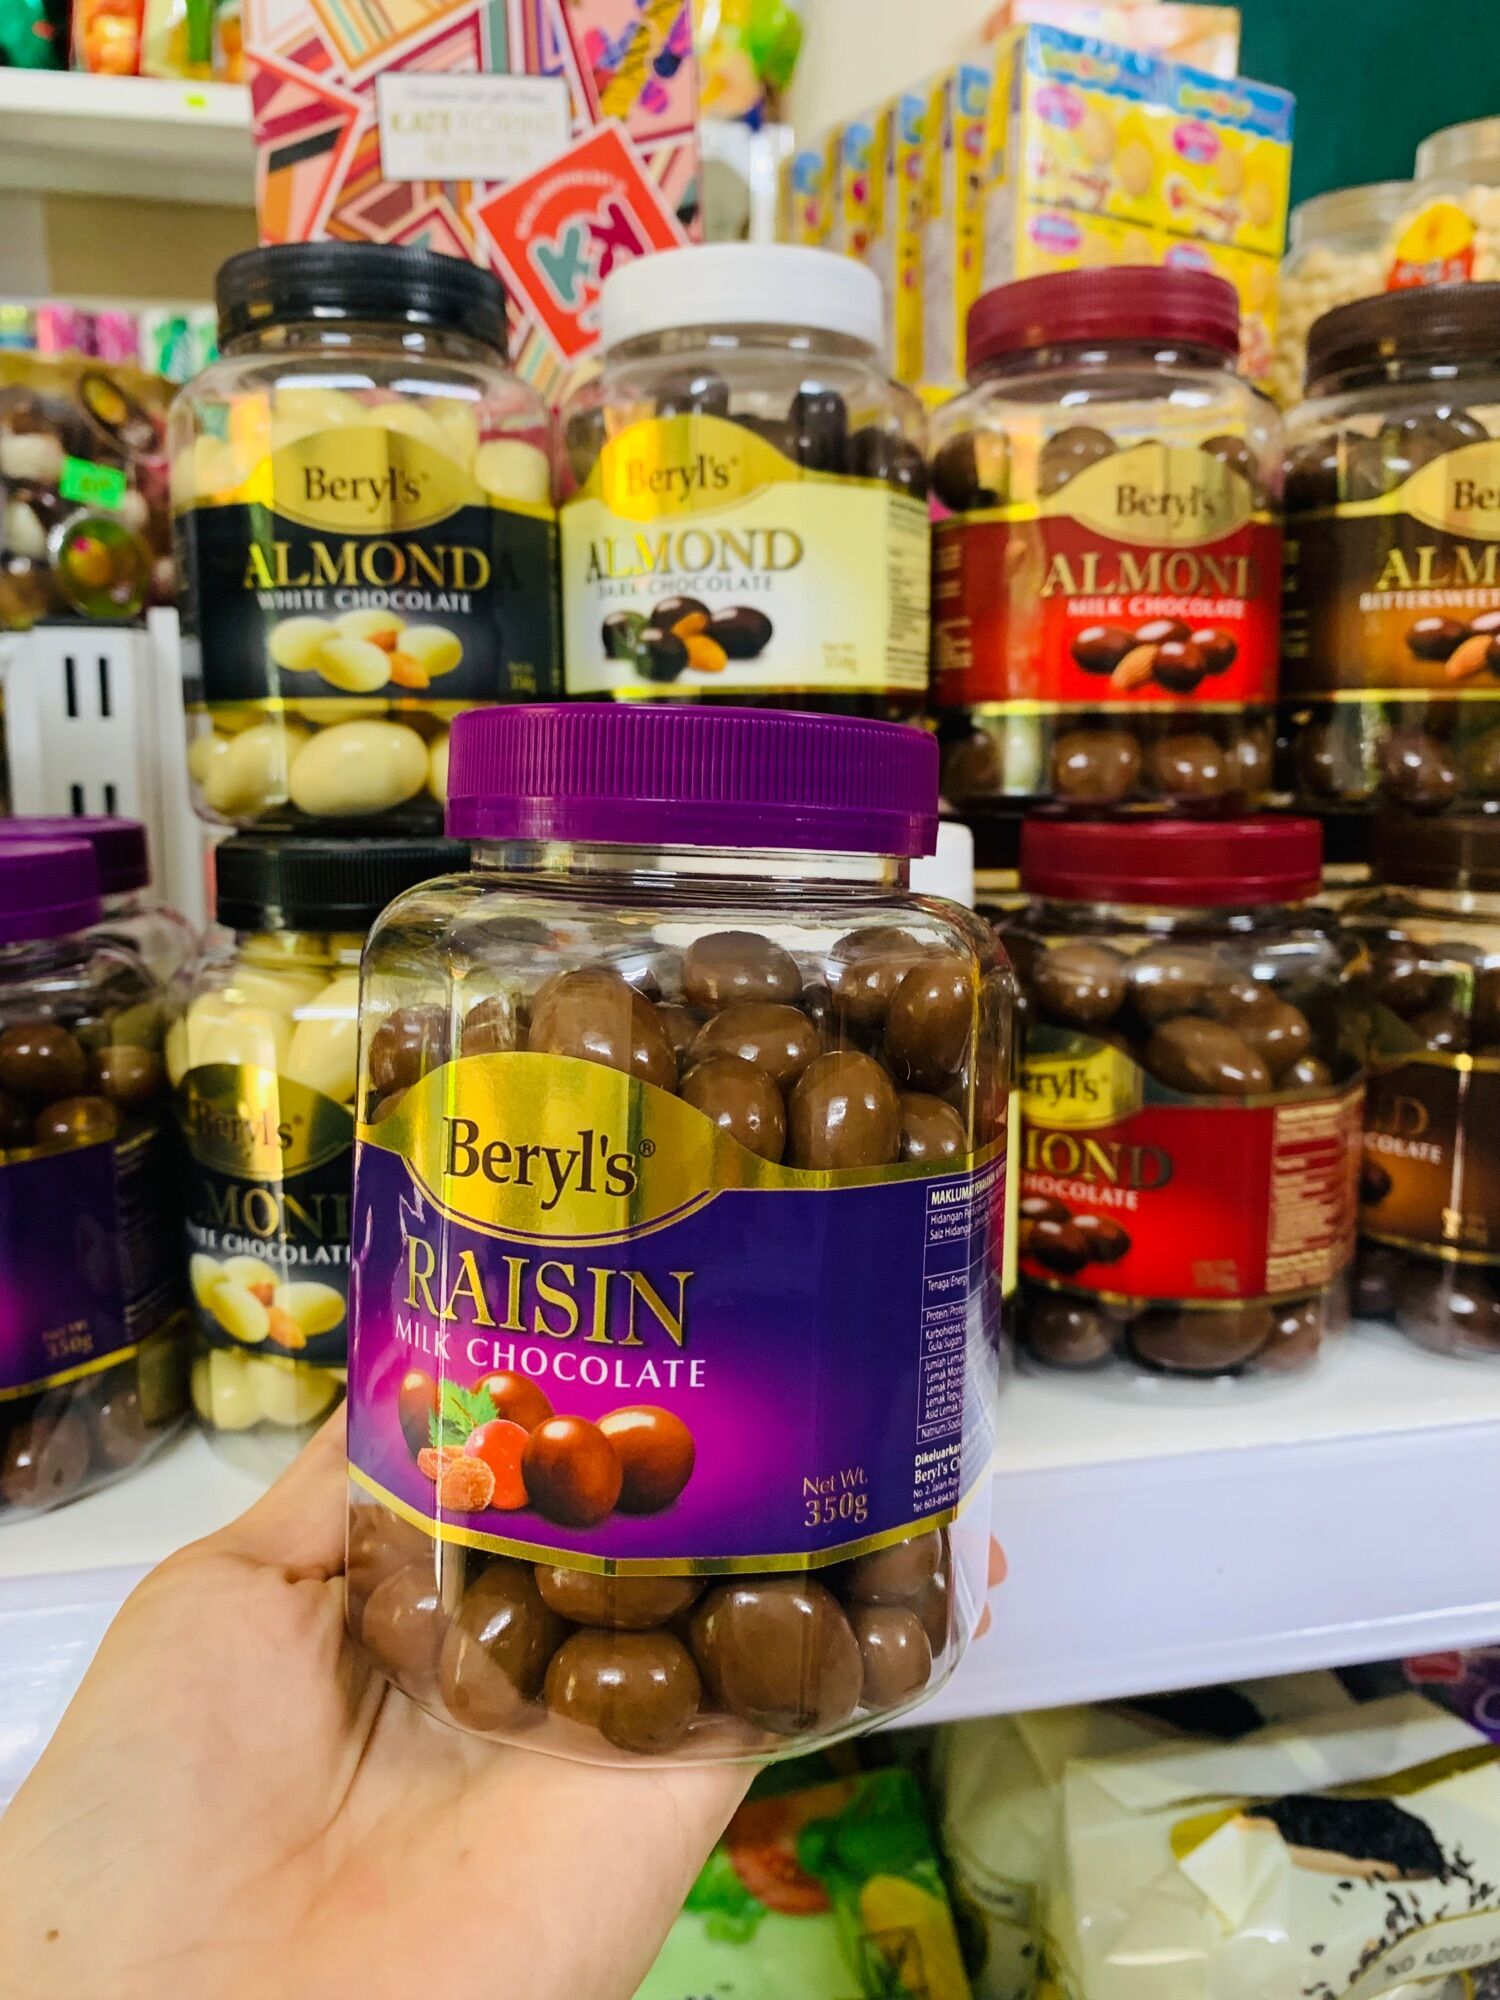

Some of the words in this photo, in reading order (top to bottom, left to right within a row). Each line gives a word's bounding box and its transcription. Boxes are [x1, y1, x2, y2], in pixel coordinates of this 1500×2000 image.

[304, 466, 422, 513] Beryl's
[627, 453, 728, 502] Beryl's
[1116, 485, 1216, 529] Beryl's
[243, 541, 491, 590] ALMOND
[586, 529, 803, 582] ALMOND
[257, 588, 326, 611] WHITE
[333, 590, 473, 615] CHOCOLATE
[648, 575, 773, 596] CHOCOLATE
[1067, 597, 1122, 617] MILK
[1128, 596, 1245, 620] CHOCOLATE
[443, 1116, 637, 1211] Beryl's
[403, 1234, 695, 1348] RAISIN
[395, 1312, 451, 1360] MILK
[466, 1337, 706, 1389] CHOCOLATE
[802, 1475, 835, 1497] Net
[914, 1462, 949, 1485] Beryl's
[804, 1492, 868, 1527] 350g
